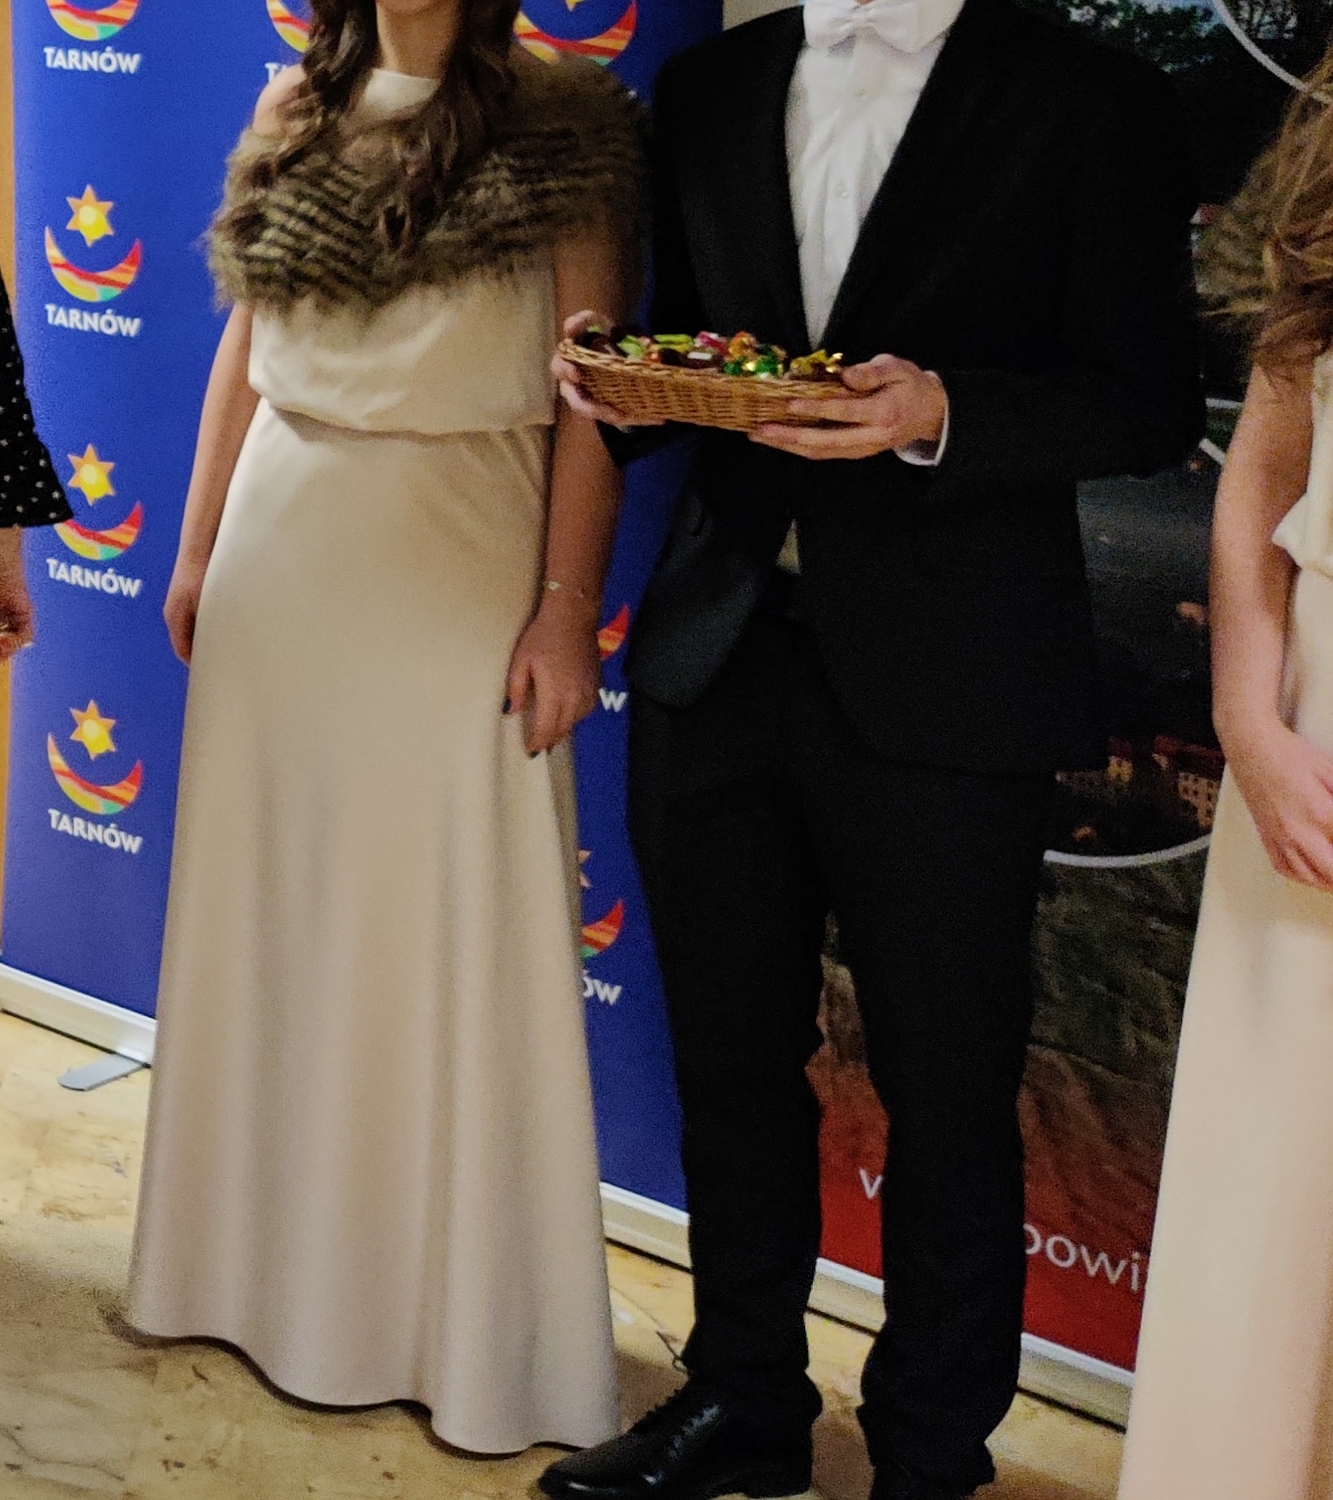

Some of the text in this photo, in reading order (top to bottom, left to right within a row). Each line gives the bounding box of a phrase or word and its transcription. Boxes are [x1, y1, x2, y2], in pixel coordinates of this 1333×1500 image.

[43, 45, 141, 74] TARNÓW
[44, 303, 142, 338] TARNÓW
[45, 557, 142, 599] TARNÓW
[47, 807, 144, 855] TARNÓW
